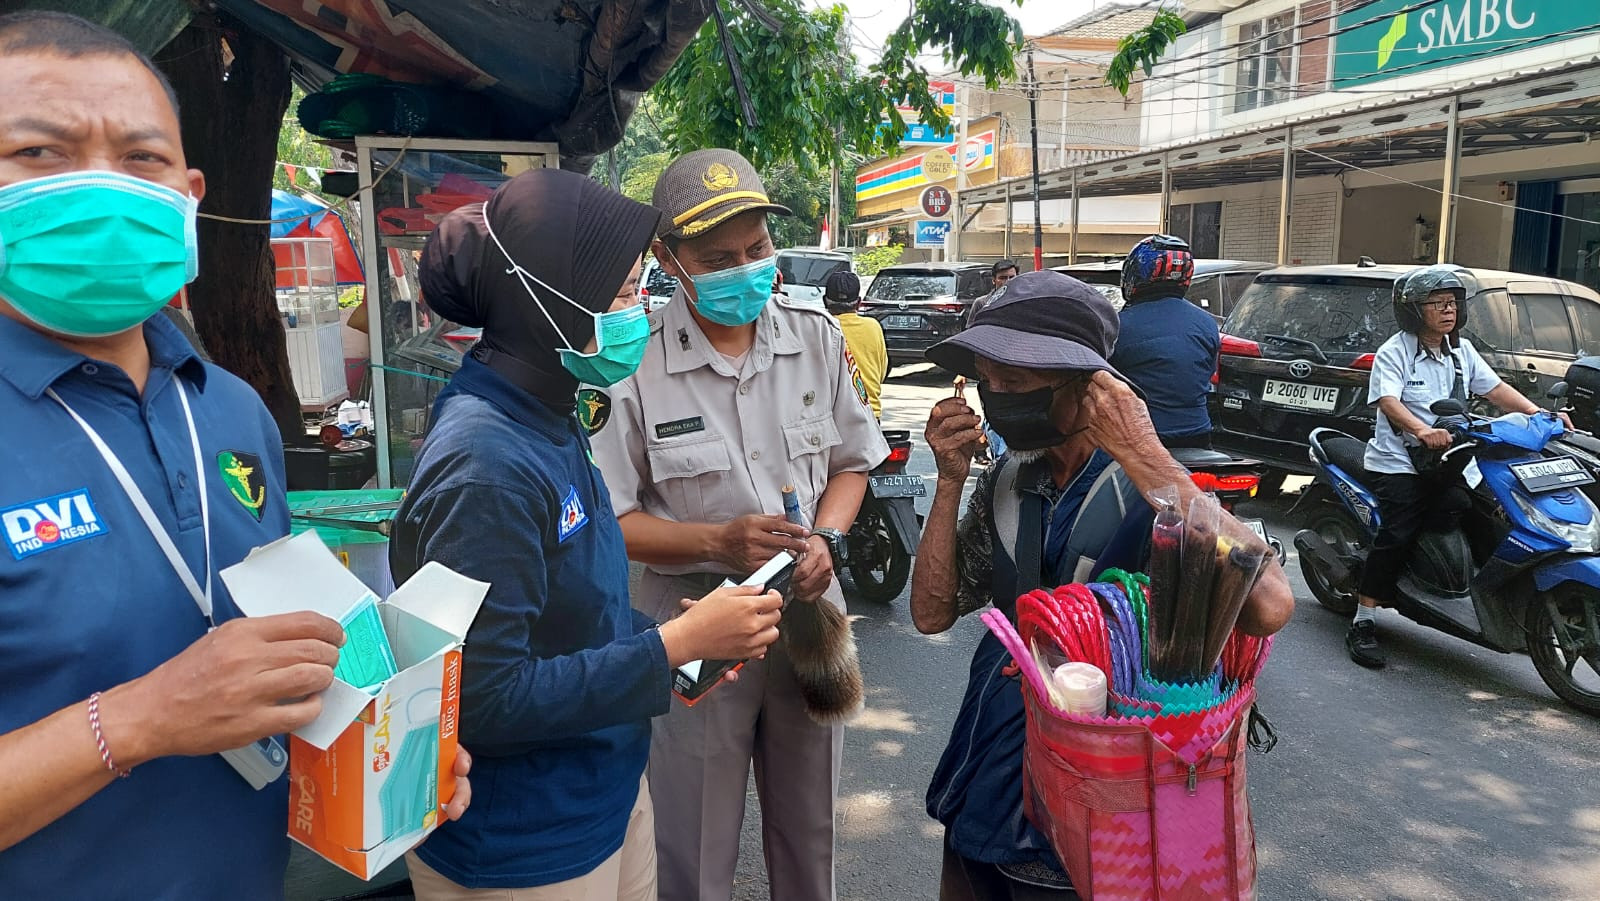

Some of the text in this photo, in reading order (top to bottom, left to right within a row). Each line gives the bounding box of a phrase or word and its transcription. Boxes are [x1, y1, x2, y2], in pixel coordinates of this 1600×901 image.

[1417, 0, 1536, 54] SMBC
[925, 161, 951, 169] COFFEE
[929, 190, 945, 198] SAY
[920, 226, 945, 235] ATM
[1266, 381, 1337, 402] B 2060 UYE
[871, 477, 878, 487] B
[884, 476, 903, 486] 4247
[1518, 468, 1528, 478] B
[2, 494, 97, 541] DVI
[1507, 536, 1534, 553] HONDA
[443, 656, 458, 739] face mask
[295, 776, 316, 835] CARE
